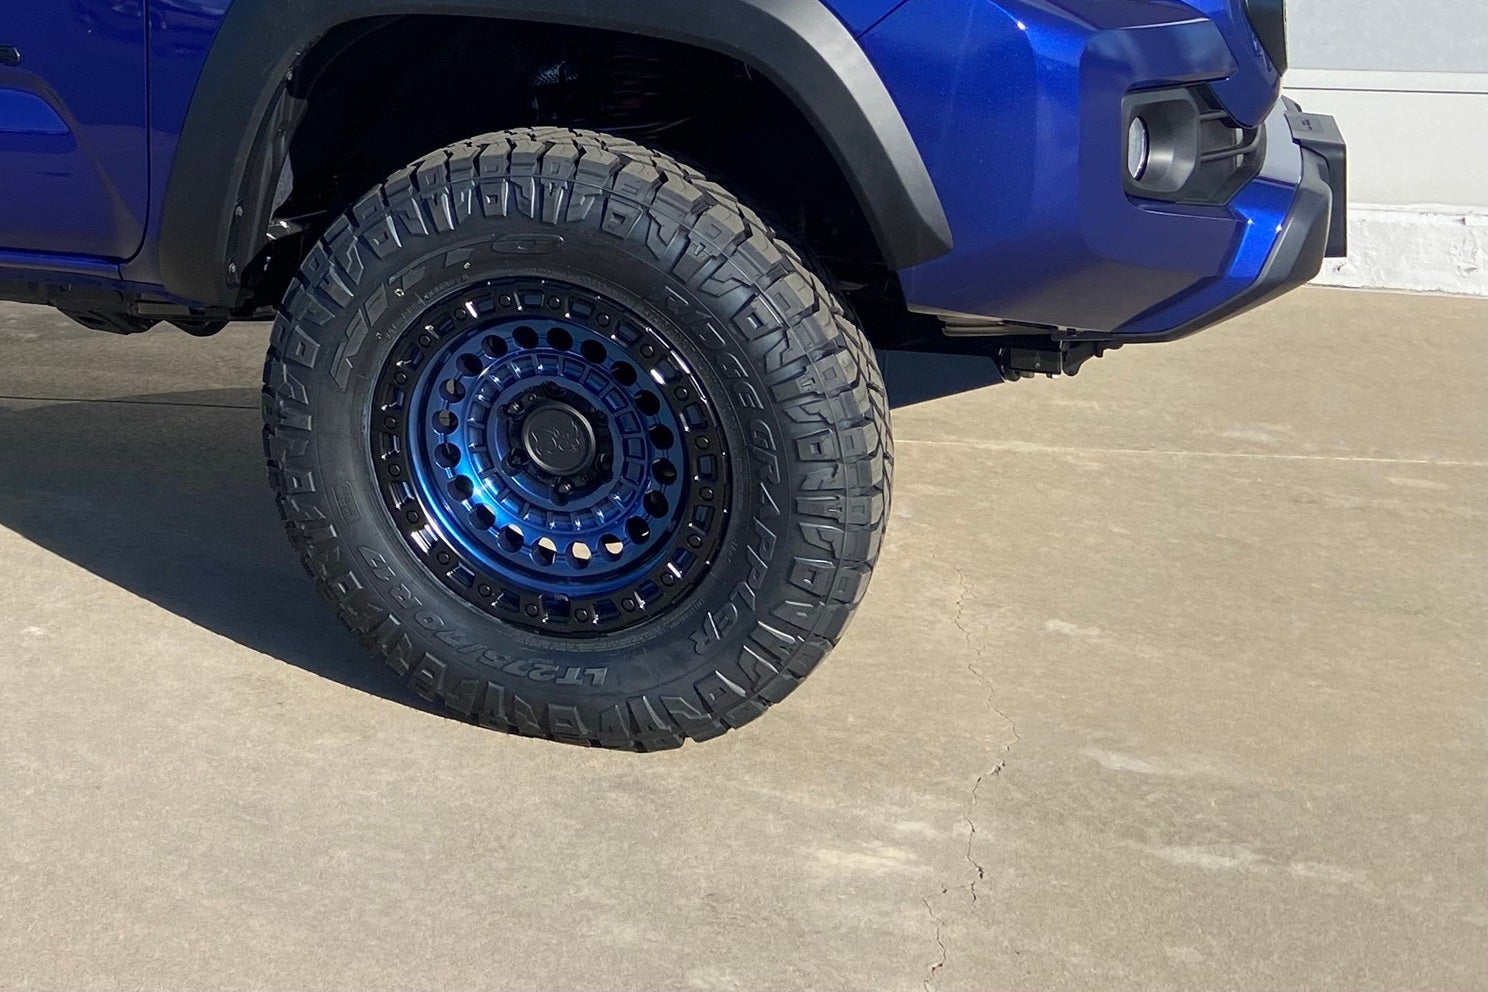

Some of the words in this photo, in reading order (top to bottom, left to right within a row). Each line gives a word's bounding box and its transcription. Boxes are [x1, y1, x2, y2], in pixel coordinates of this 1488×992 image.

[330, 232, 568, 390] NITTO
[665, 286, 765, 414] RIDGE
[689, 420, 784, 653] GRAPPLER
